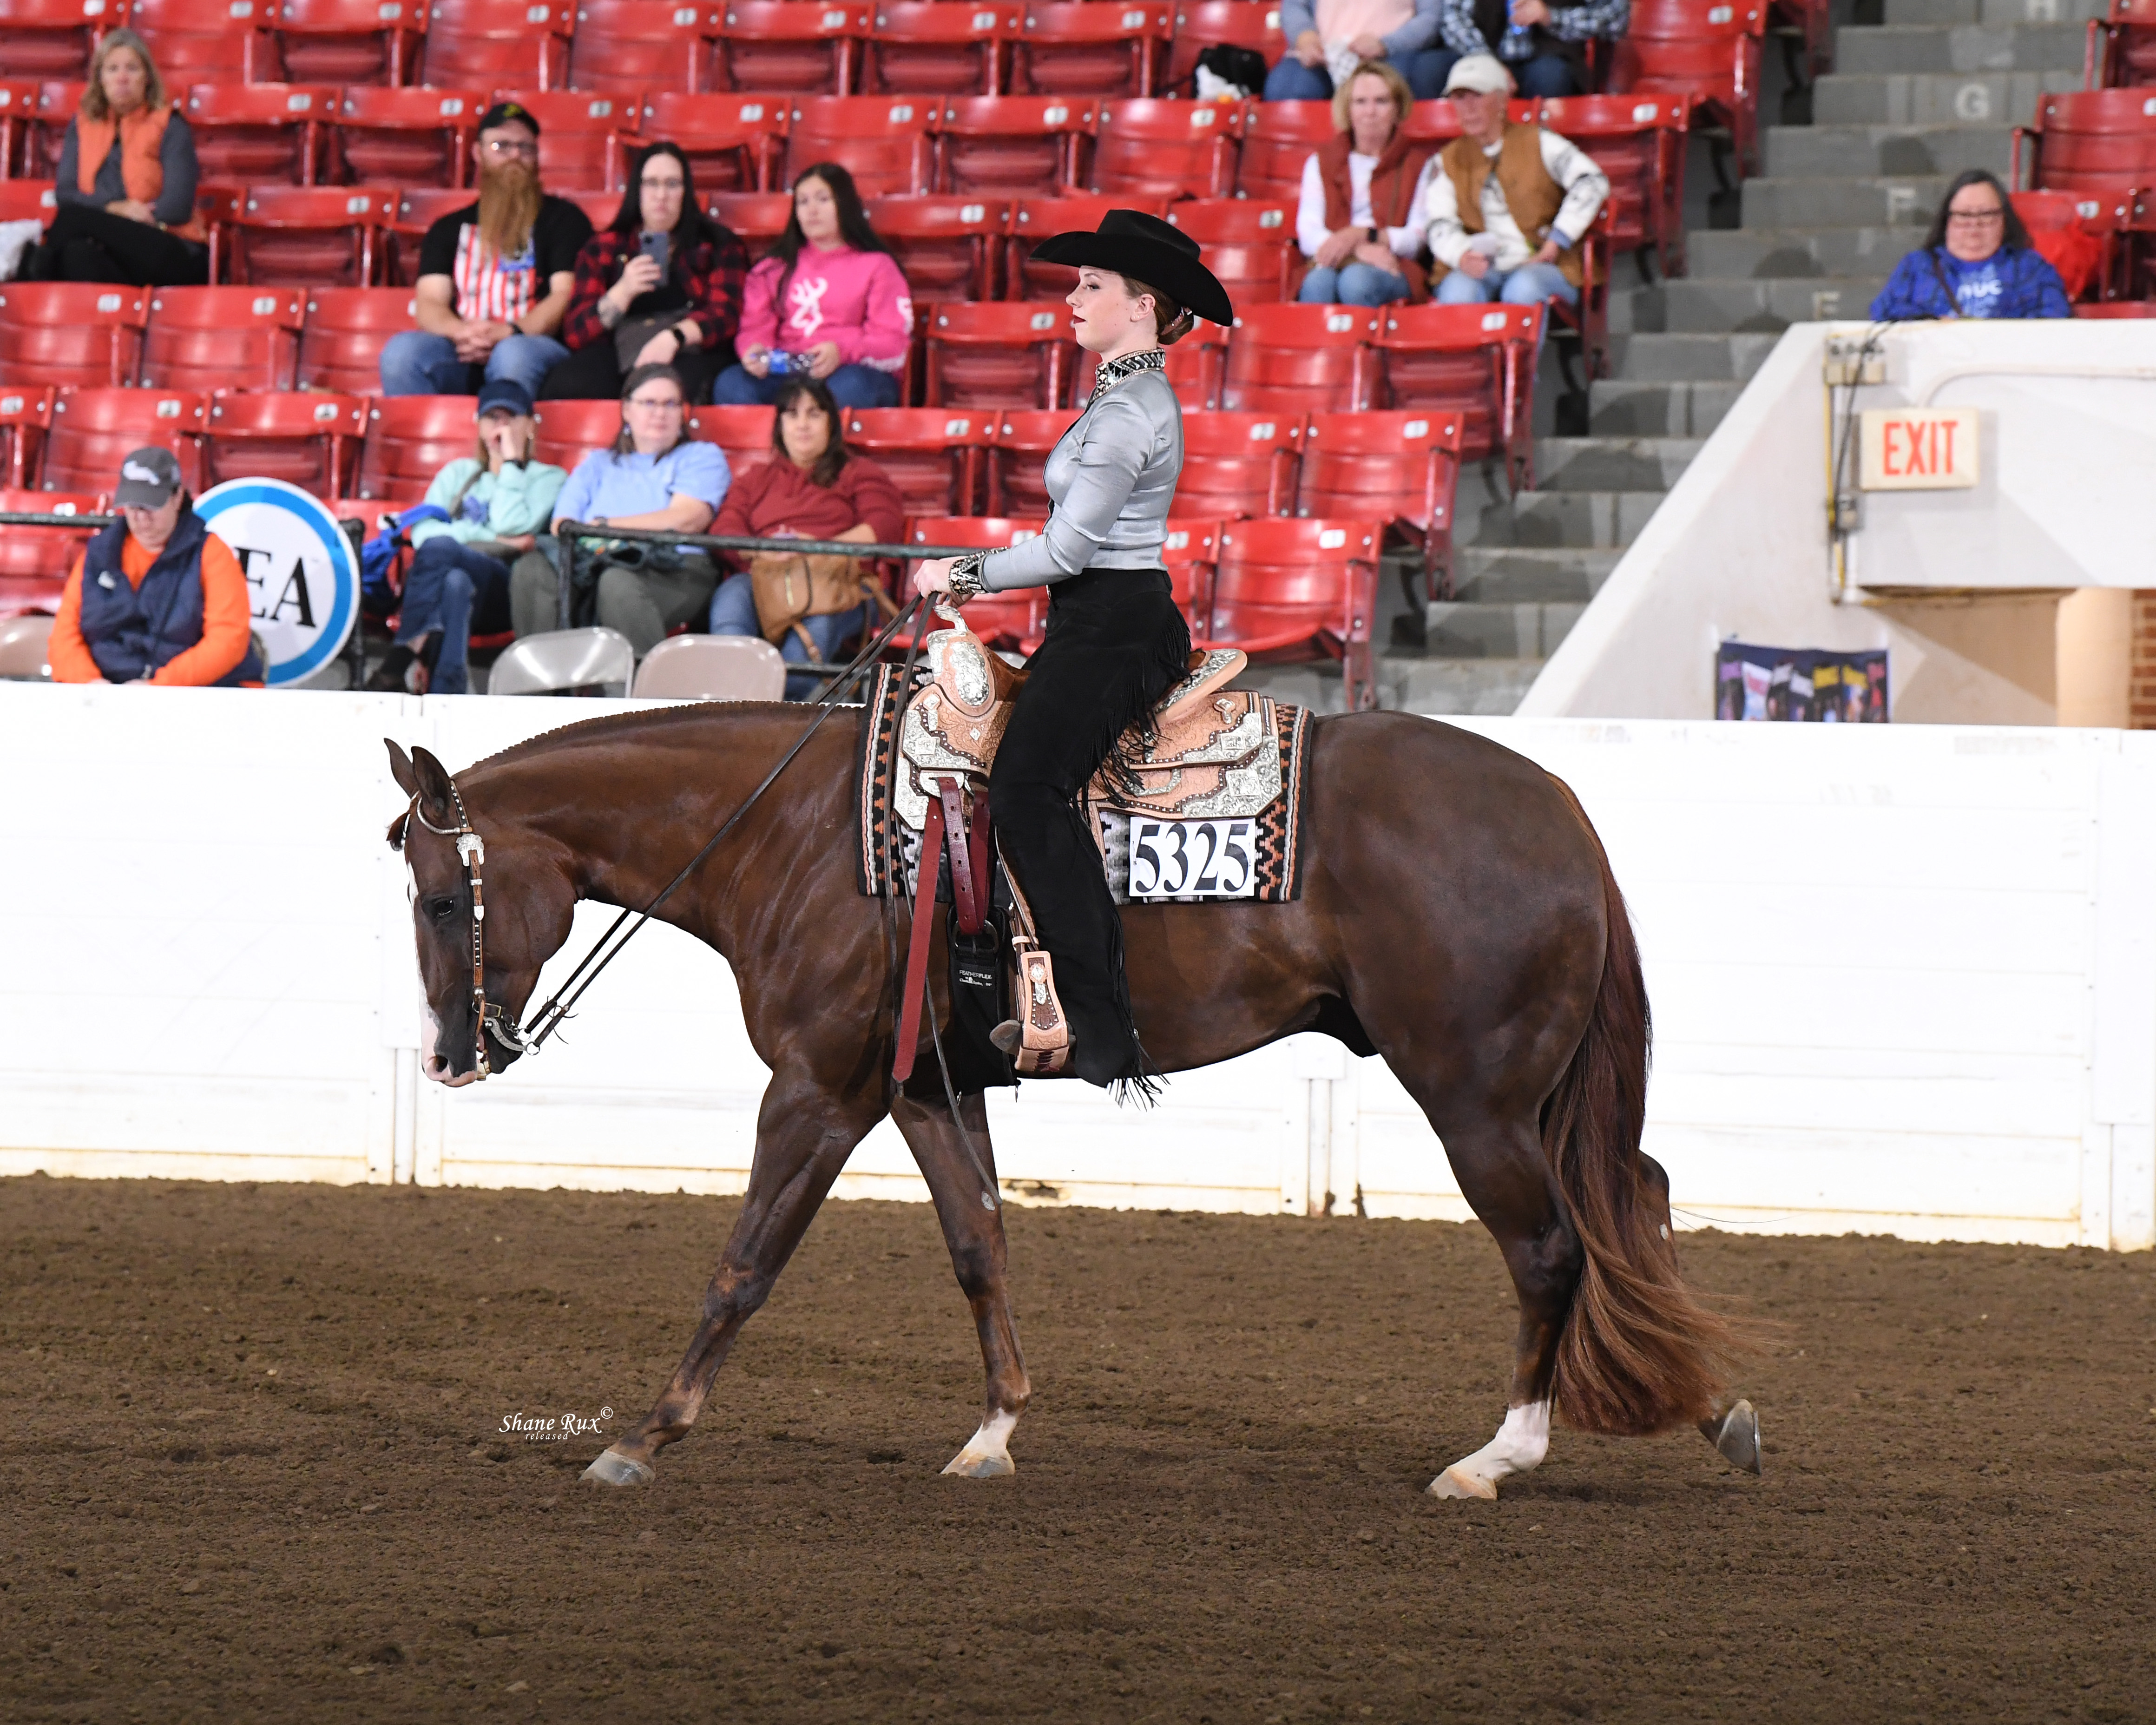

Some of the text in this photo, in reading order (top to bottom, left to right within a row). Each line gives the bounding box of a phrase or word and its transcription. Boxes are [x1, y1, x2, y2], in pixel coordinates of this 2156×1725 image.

[1954, 83, 1990, 120] G
[1886, 187, 1916, 224] F
[1884, 420, 1958, 475] EXIT
[1136, 823, 1249, 893] 5325
